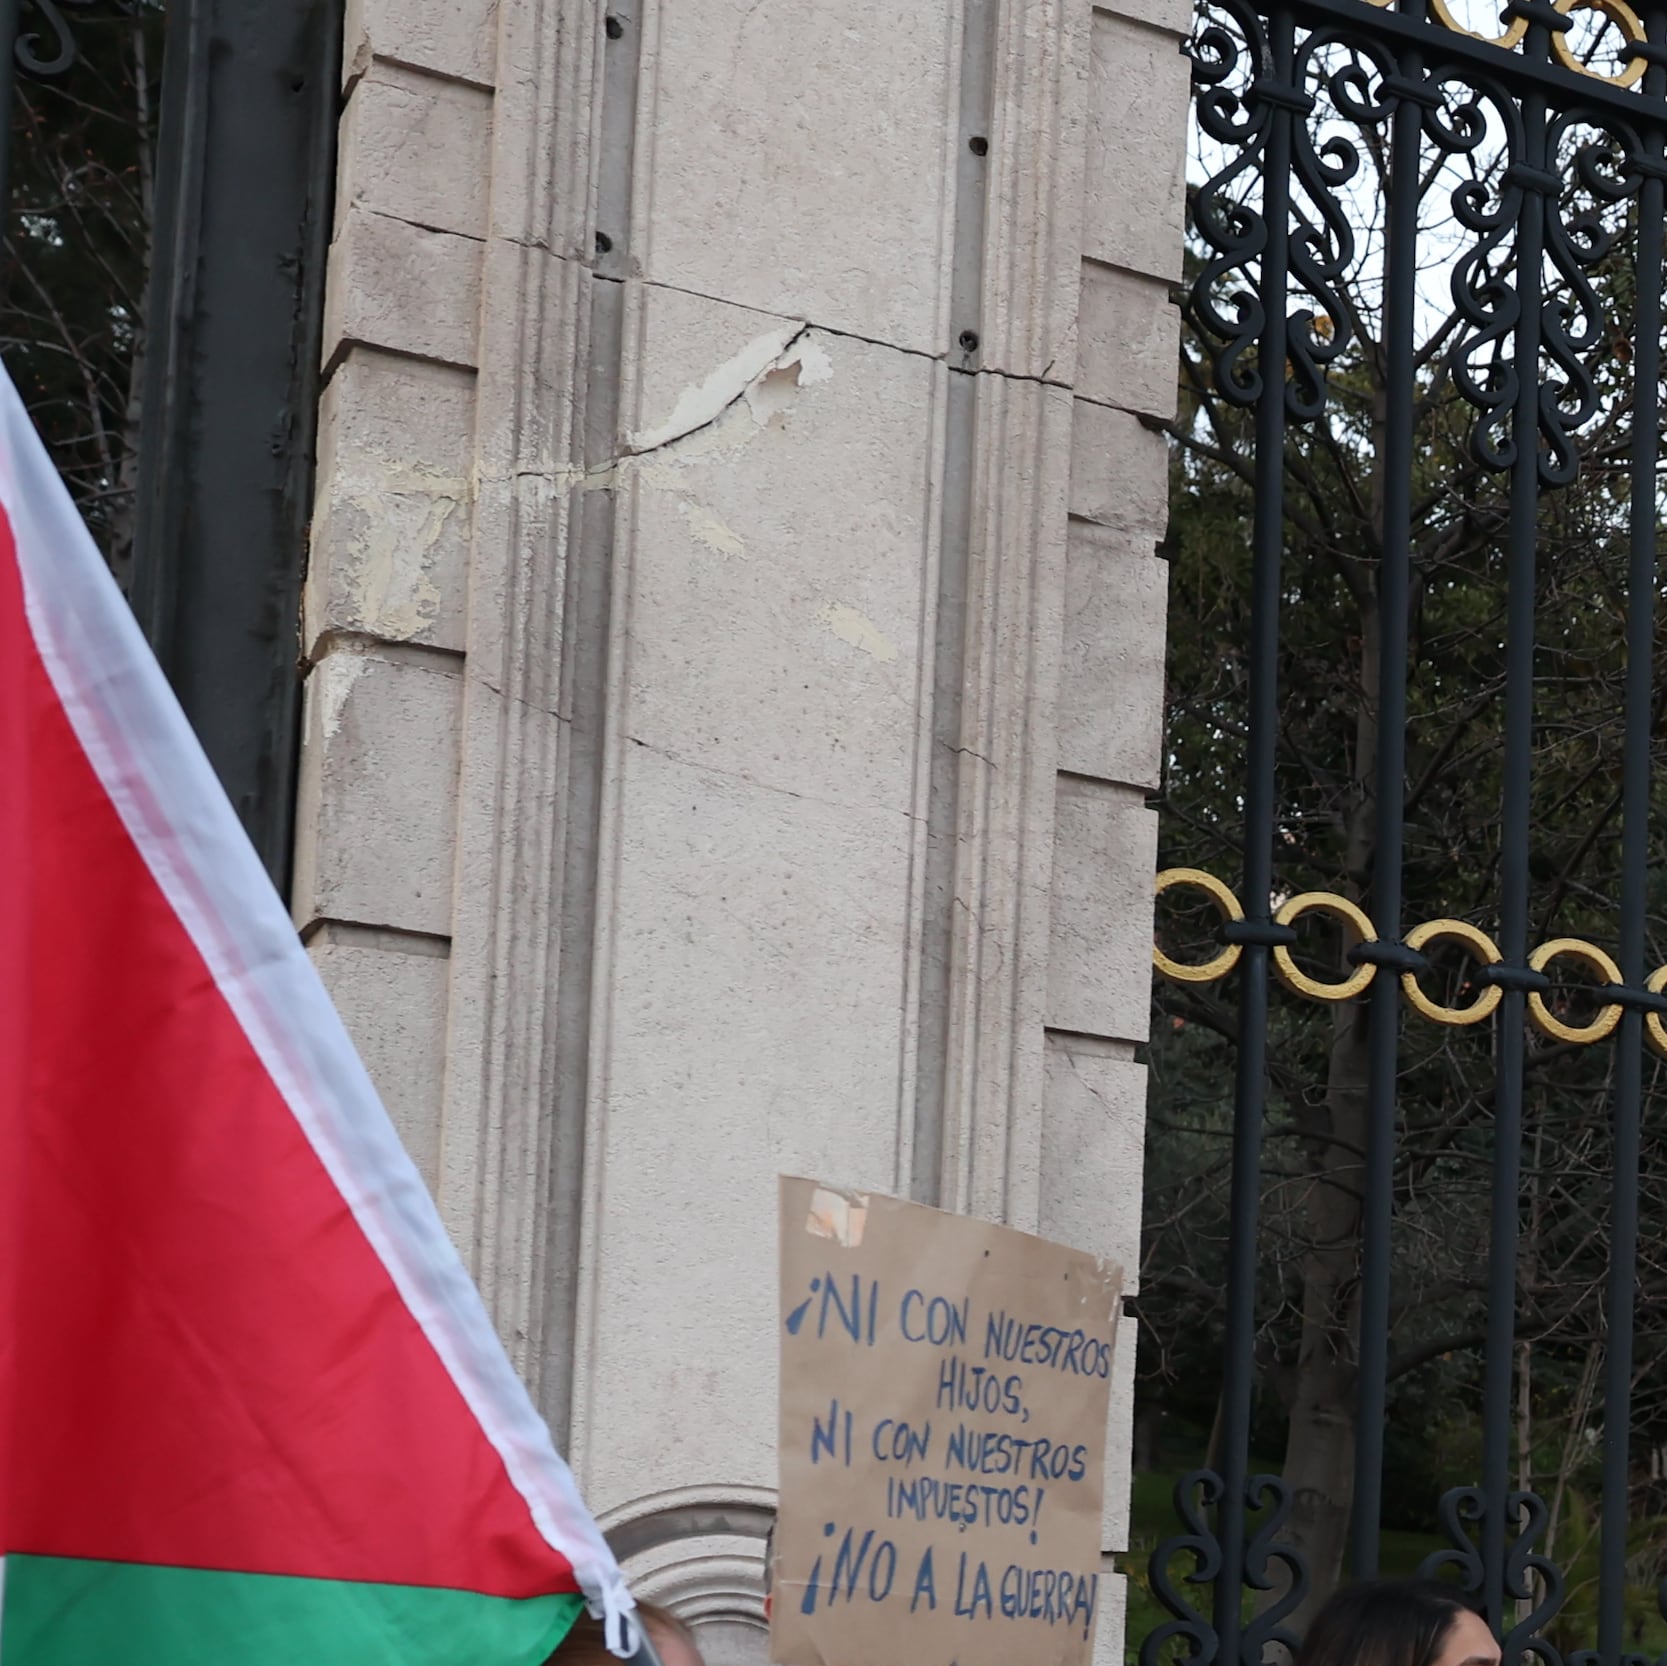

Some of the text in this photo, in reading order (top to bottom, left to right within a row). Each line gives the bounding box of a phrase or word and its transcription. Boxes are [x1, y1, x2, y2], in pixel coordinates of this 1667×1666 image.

[785, 1272, 1113, 1379] ¡NI CON NUESTROS
[937, 1355, 1031, 1424] HIJOS,
[811, 1397, 1088, 1481] NI CON NUESTROS
[888, 1476, 1045, 1545] IMPUESTOS!
[801, 1522, 1098, 1641] ¡NO A LA GUERRA!
